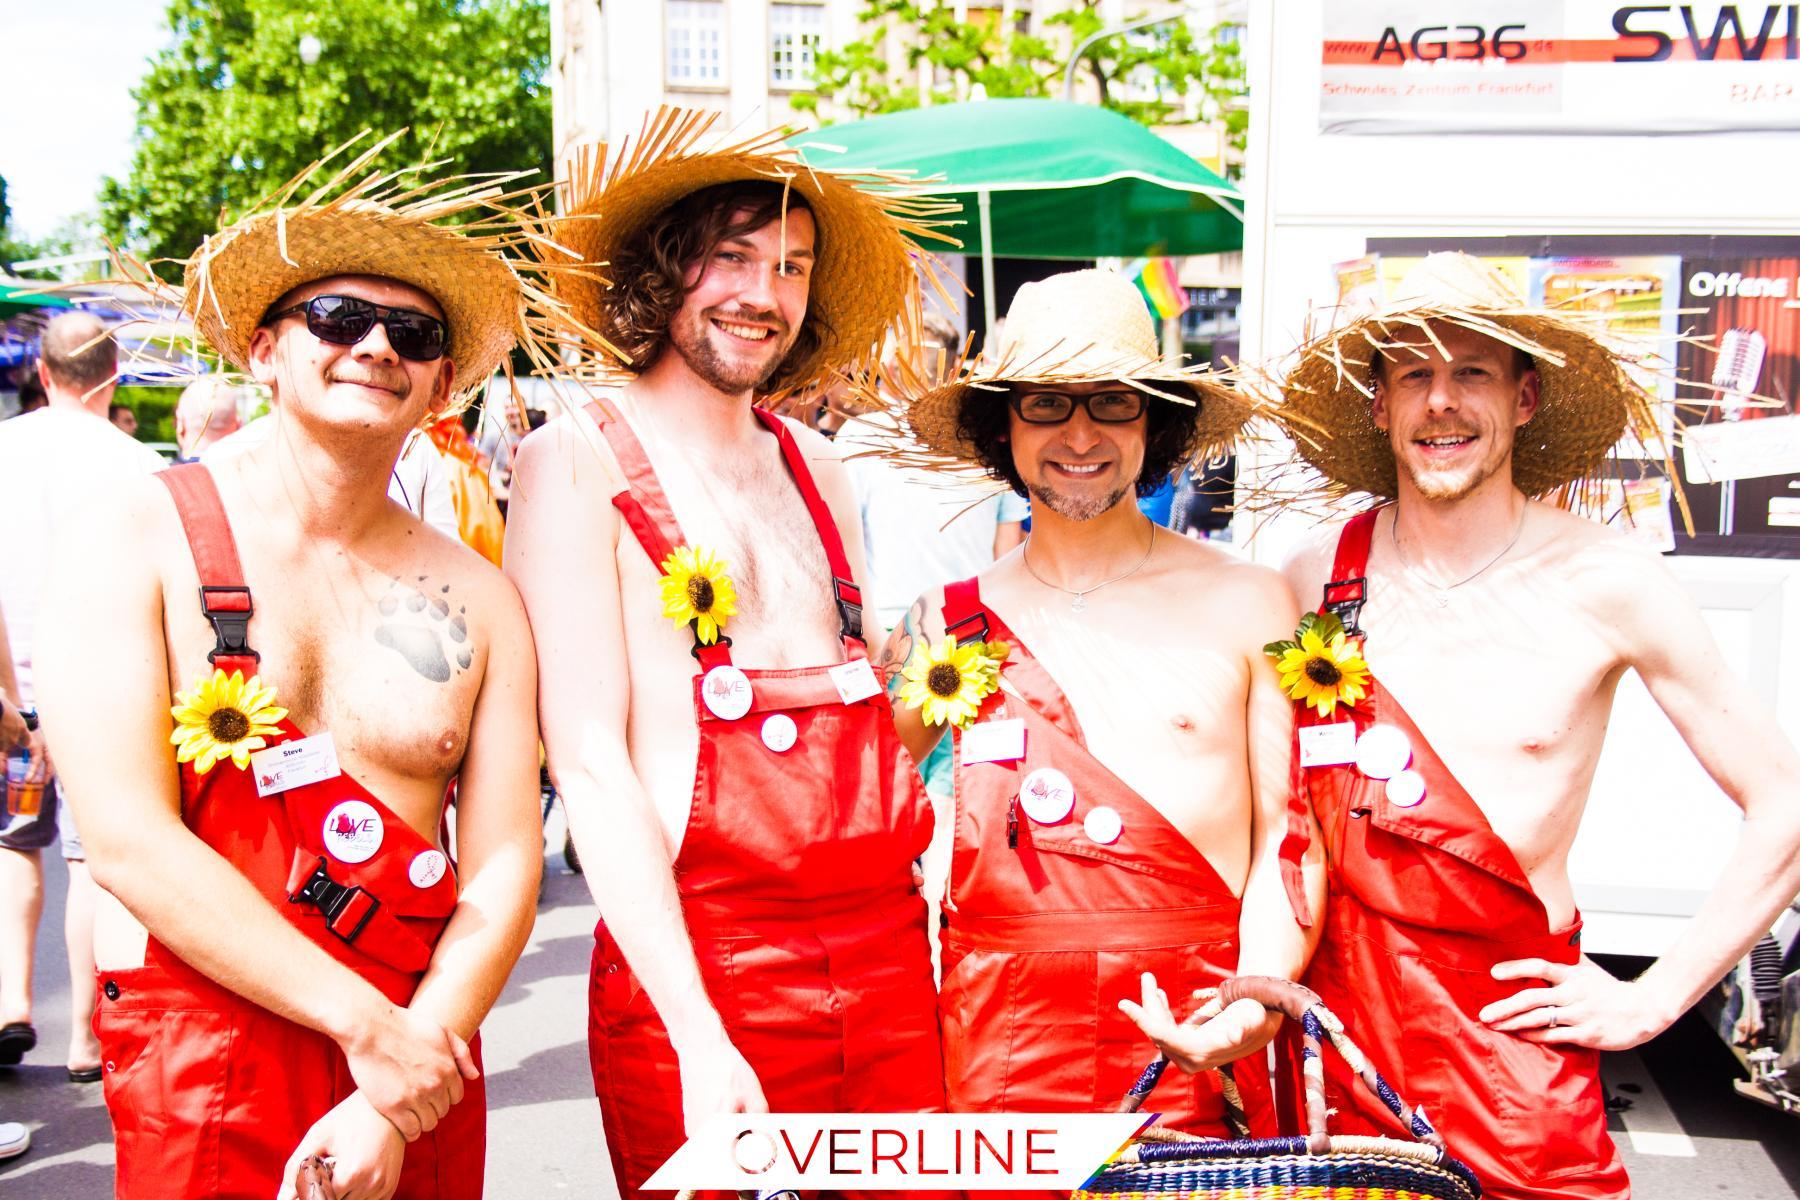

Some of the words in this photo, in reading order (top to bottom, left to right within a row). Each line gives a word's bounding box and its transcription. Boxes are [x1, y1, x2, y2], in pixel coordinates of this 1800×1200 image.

[1612, 5, 1799, 62] SWI
[1689, 272, 1788, 297] Offene
[283, 748, 303, 757] Steve
